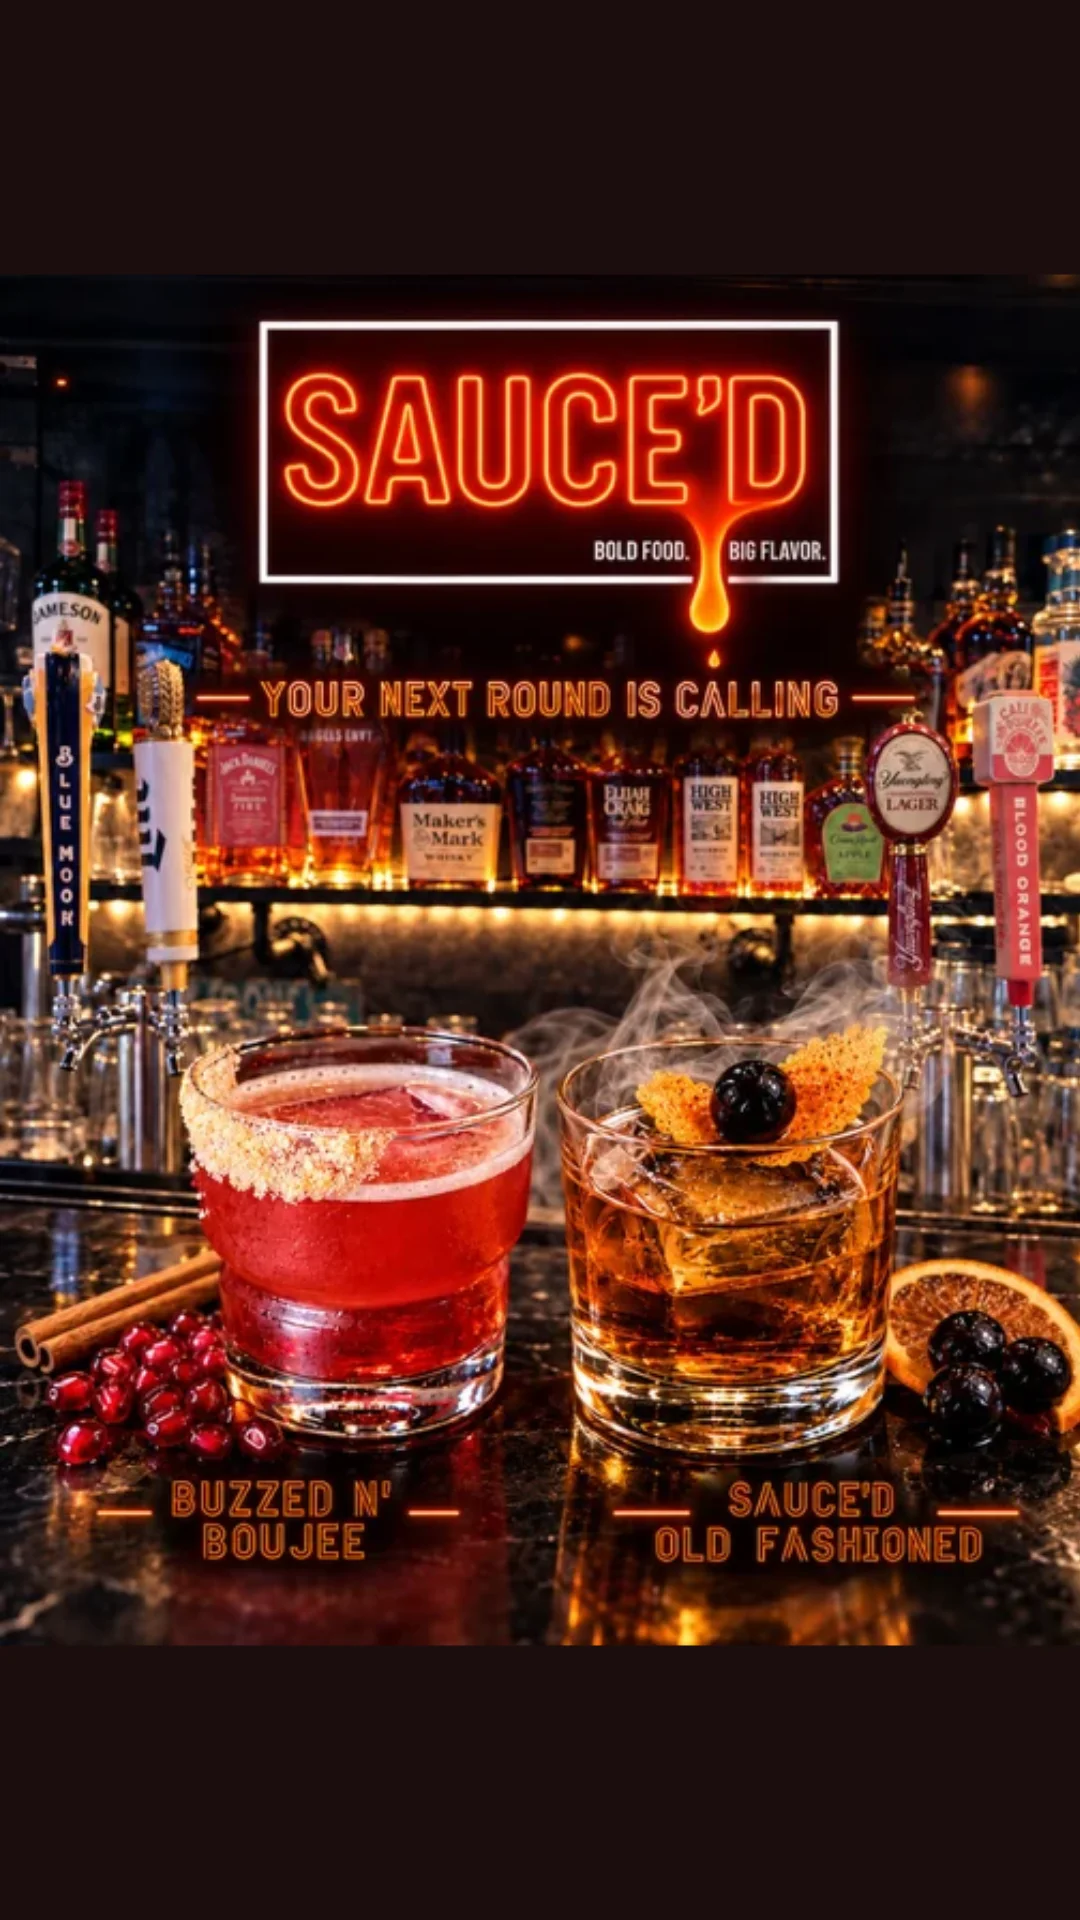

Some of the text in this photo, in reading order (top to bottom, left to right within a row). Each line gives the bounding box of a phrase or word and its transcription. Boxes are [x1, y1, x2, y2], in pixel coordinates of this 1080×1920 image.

[603, 784, 651, 802] ELIJAH
[691, 784, 731, 798] HIGH
[760, 790, 800, 804] HIGH
[603, 800, 651, 818] CRAIG
[691, 798, 731, 811] WEST
[761, 803, 799, 817] WEST
[886, 799, 939, 811] LAGER
[413, 812, 486, 829] Maker's
[56, 745, 74, 926] BLUE MOON
[431, 831, 484, 847] Mark
[1014, 797, 1032, 967] BLOOD ORANGE
